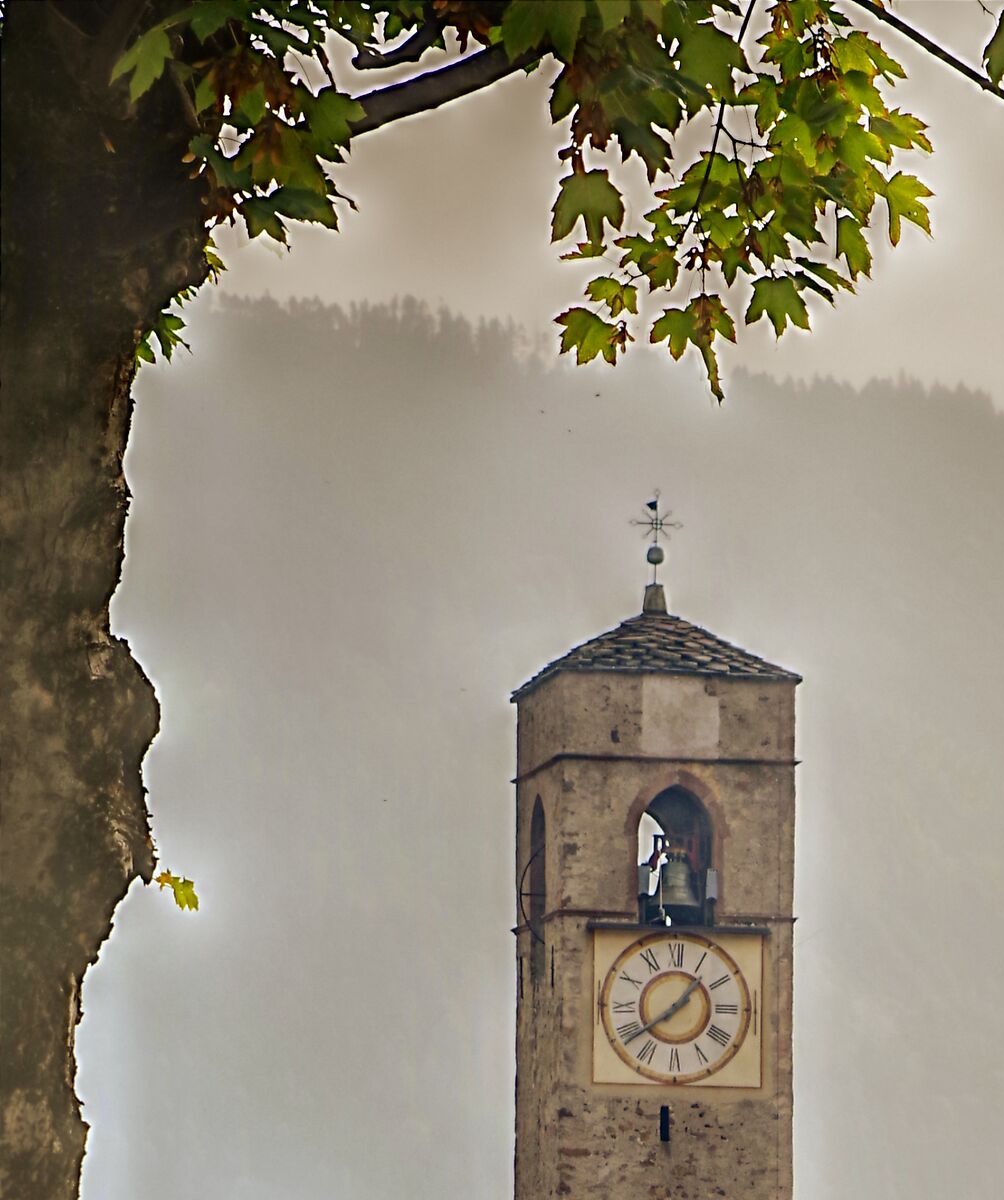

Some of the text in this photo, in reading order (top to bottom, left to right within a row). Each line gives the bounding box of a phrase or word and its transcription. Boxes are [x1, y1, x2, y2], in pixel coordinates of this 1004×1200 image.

[640, 948, 661, 974] XI
[668, 943, 684, 968] XII
[695, 952, 707, 973] I
[619, 970, 643, 990] X
[709, 974, 731, 990] II
[612, 1001, 636, 1013] IX
[715, 1004, 738, 1014] III
[637, 1040, 658, 1065] VII
[694, 1043, 709, 1065] V
